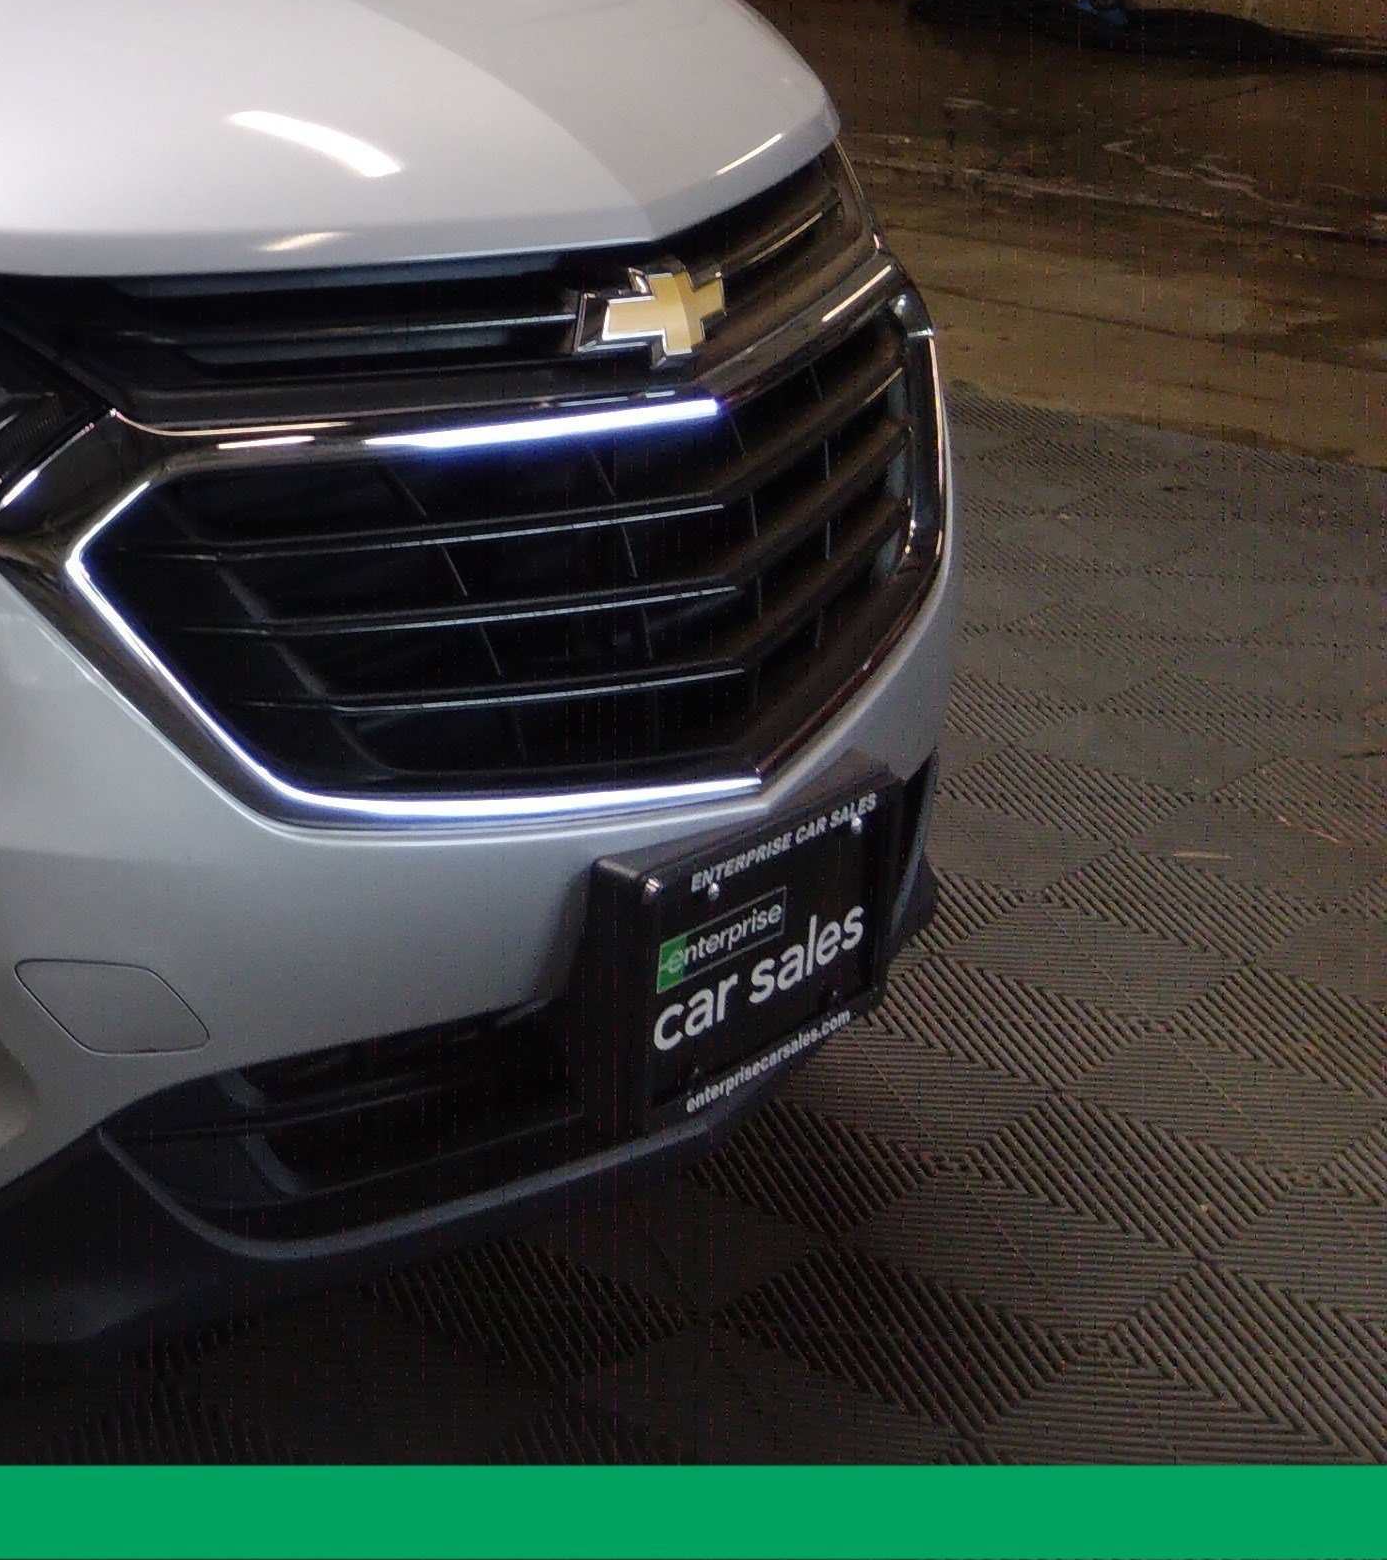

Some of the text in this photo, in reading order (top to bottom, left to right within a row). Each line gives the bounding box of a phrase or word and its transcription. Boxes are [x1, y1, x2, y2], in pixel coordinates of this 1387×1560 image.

[690, 792, 878, 893] ENTERPRISE CAR SALES
[653, 905, 865, 1052] car sales
[667, 904, 783, 975] enterprise
[686, 1009, 852, 1113] enterprisecarsales.com
